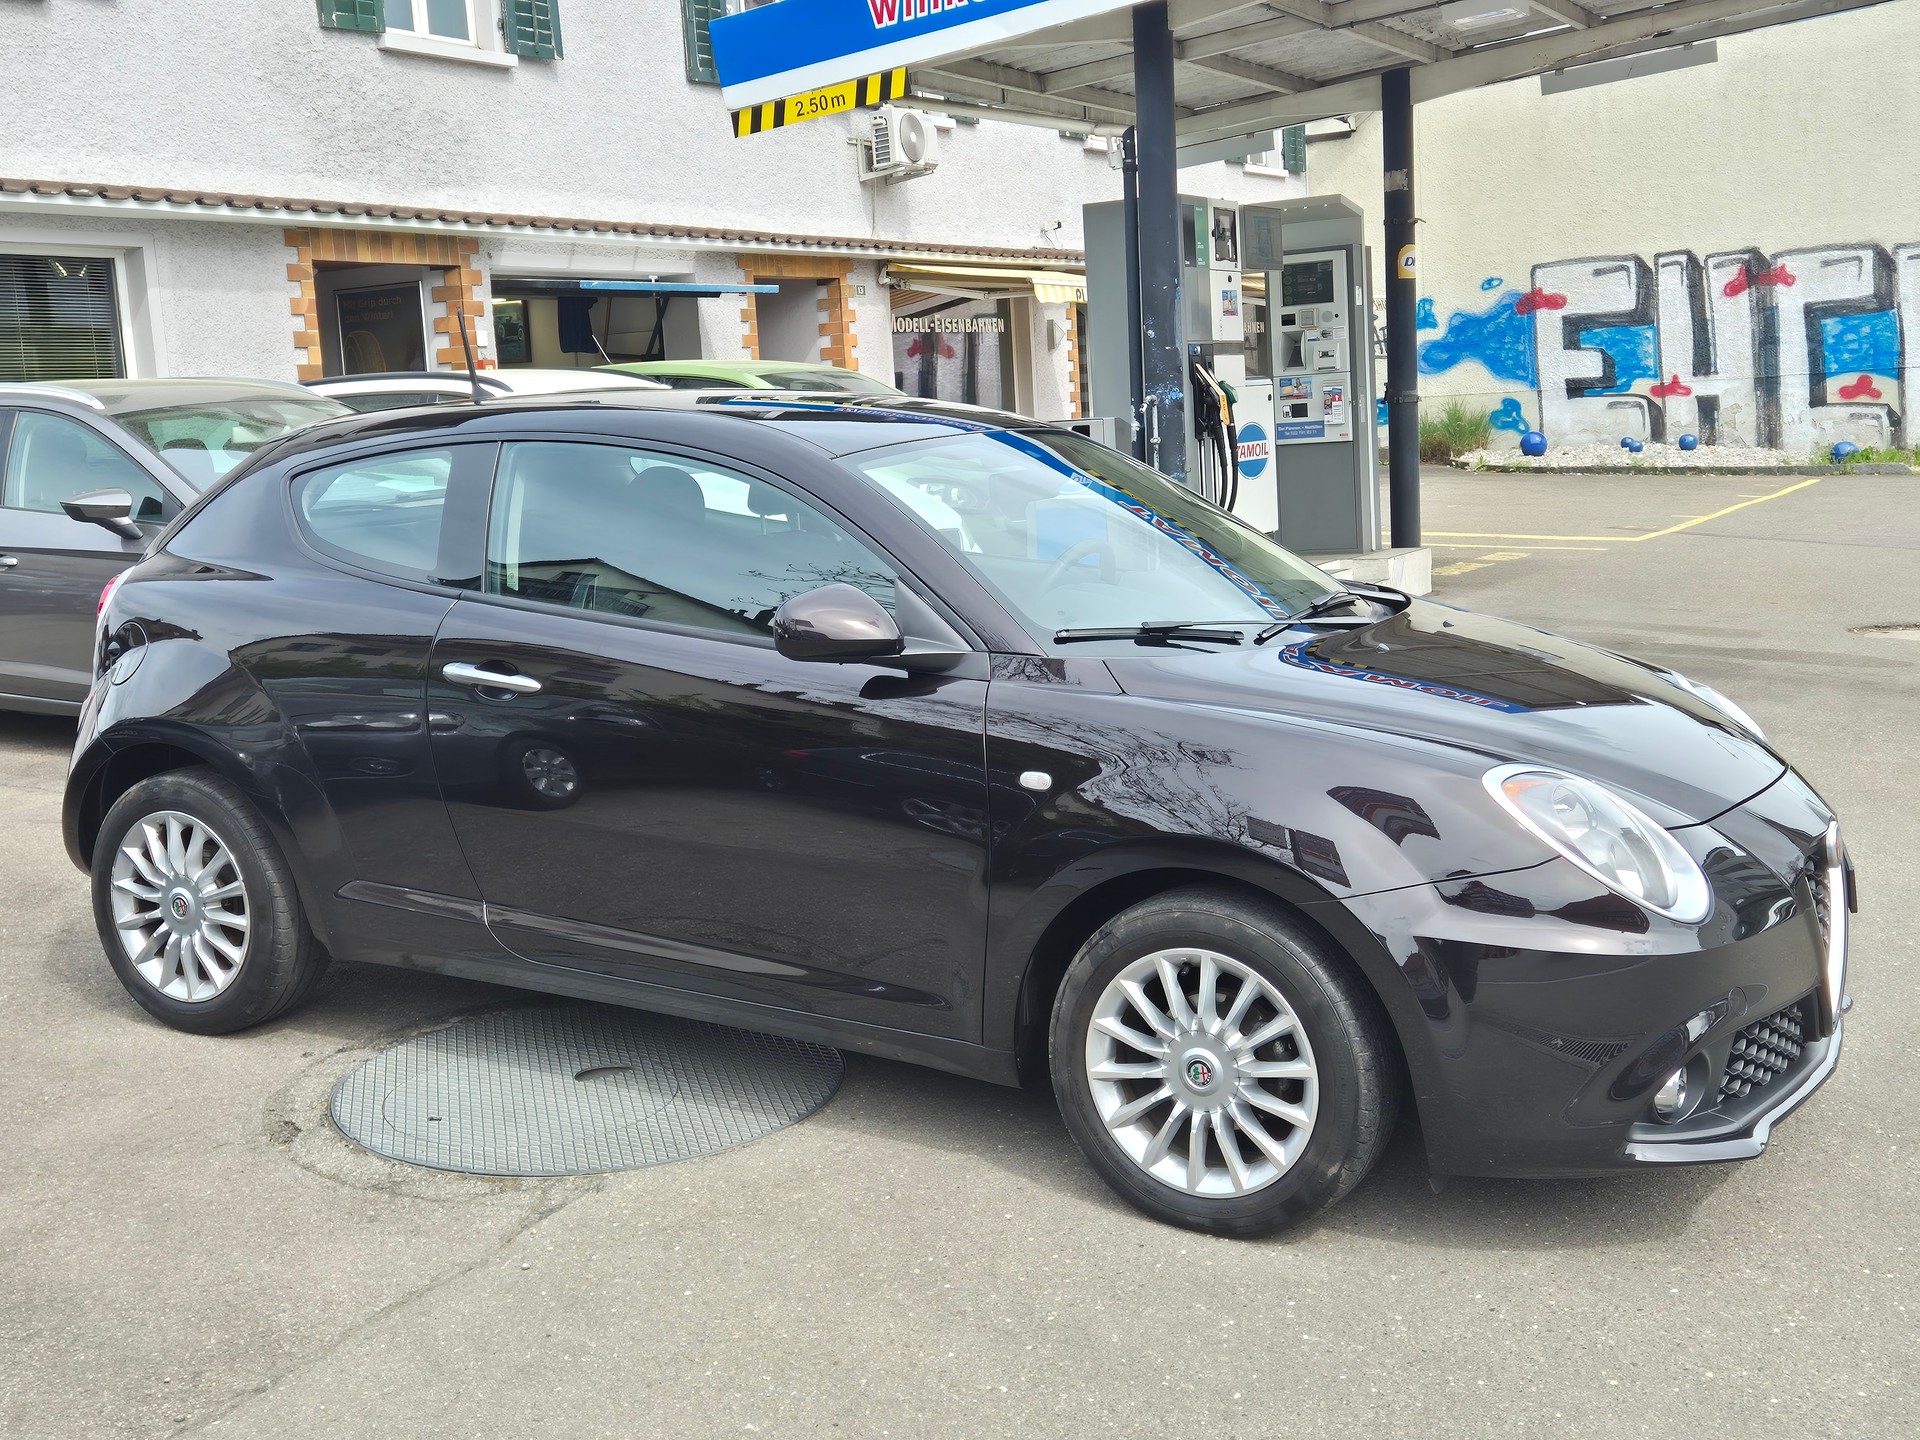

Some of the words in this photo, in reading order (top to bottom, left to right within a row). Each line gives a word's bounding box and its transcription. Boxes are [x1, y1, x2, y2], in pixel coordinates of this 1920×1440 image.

[795, 94, 828, 117] 2.50
[831, 93, 846, 108] m
[378, 295, 402, 306] durch
